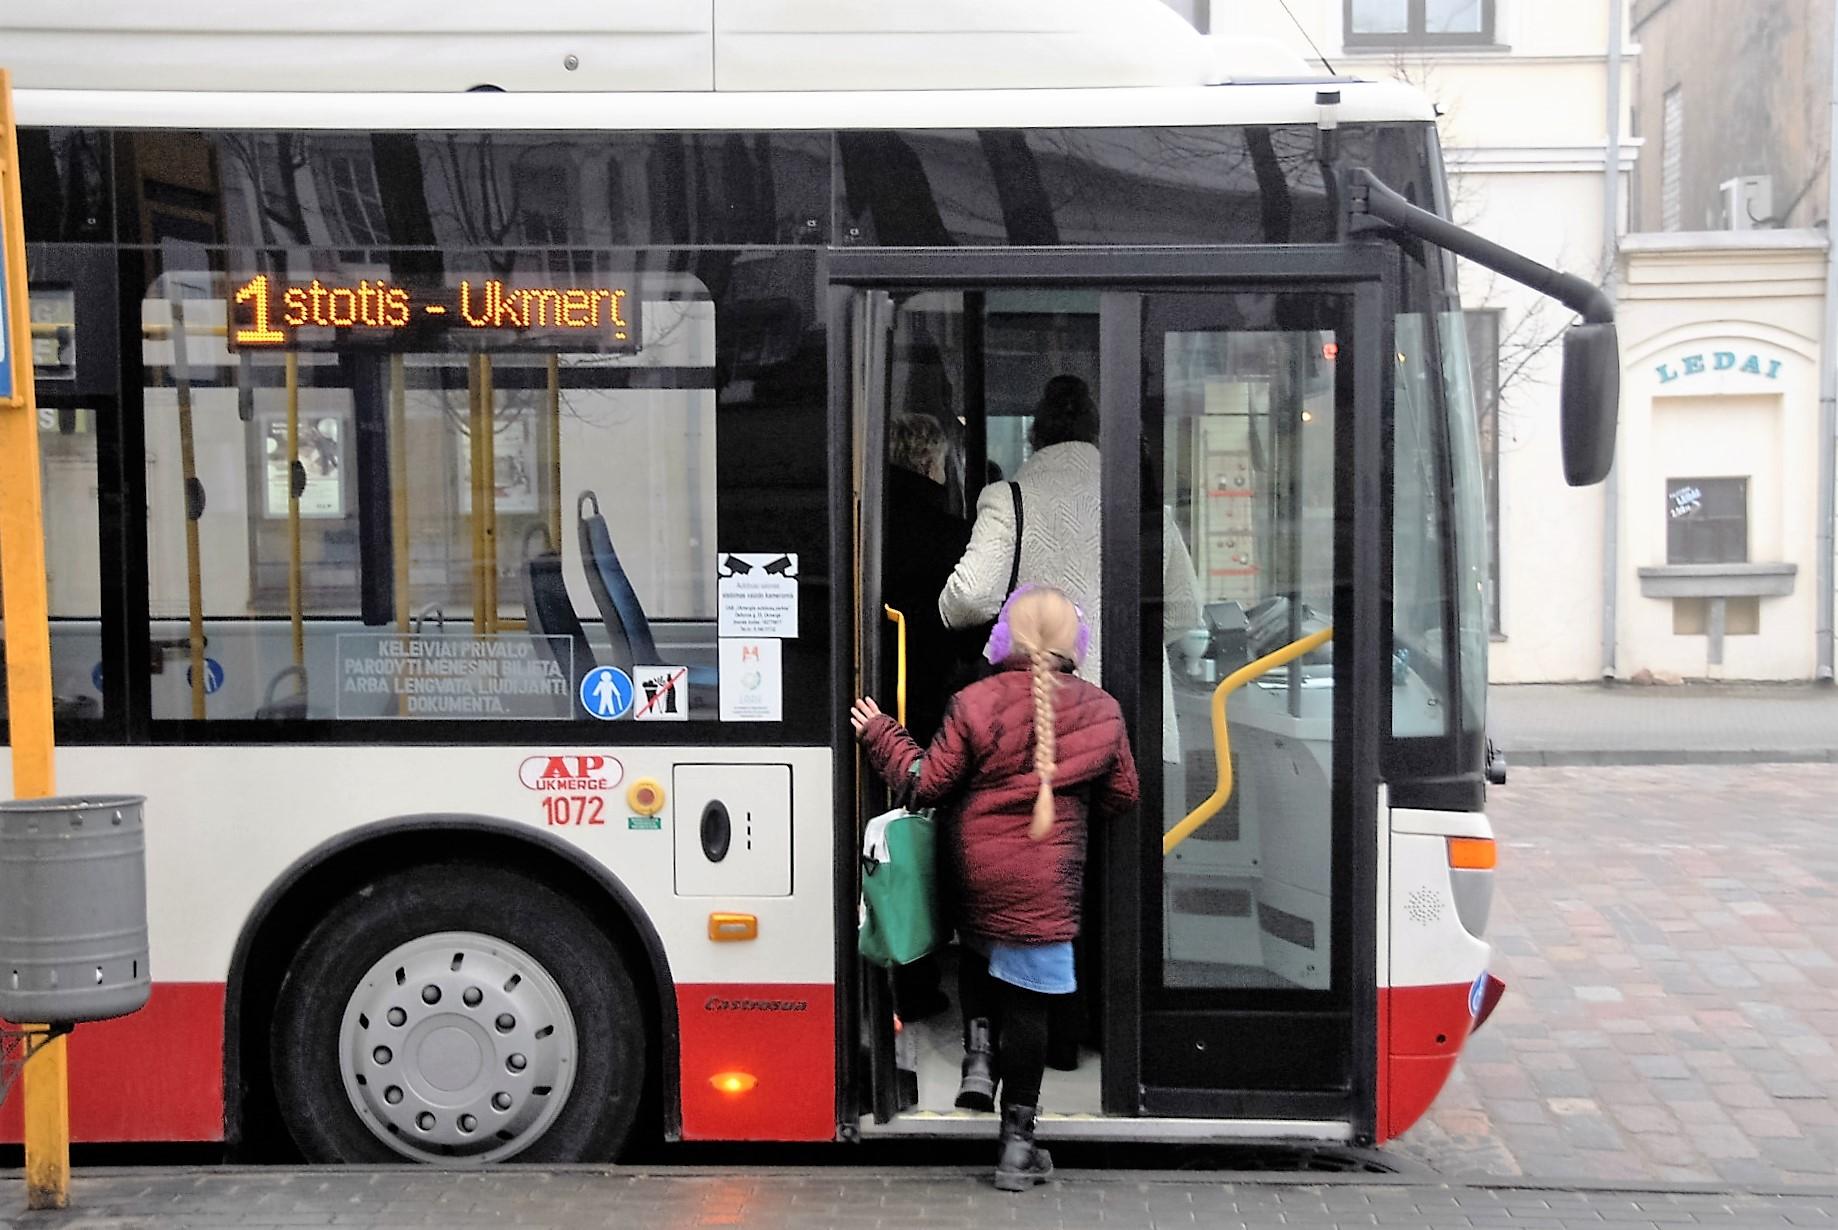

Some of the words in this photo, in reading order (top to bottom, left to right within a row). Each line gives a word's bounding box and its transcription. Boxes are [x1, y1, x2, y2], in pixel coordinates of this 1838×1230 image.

[235, 274, 285, 343] 1
[284, 279, 410, 327] stotis
[1655, 351, 1782, 384] LEDAI
[378, 640, 457, 657] KELEIVIAI
[462, 640, 528, 657] PRIVALO
[344, 659, 422, 675] PARODYTI
[344, 678, 389, 694] ARBA
[540, 755, 604, 778] AP
[542, 796, 605, 825] 1072
